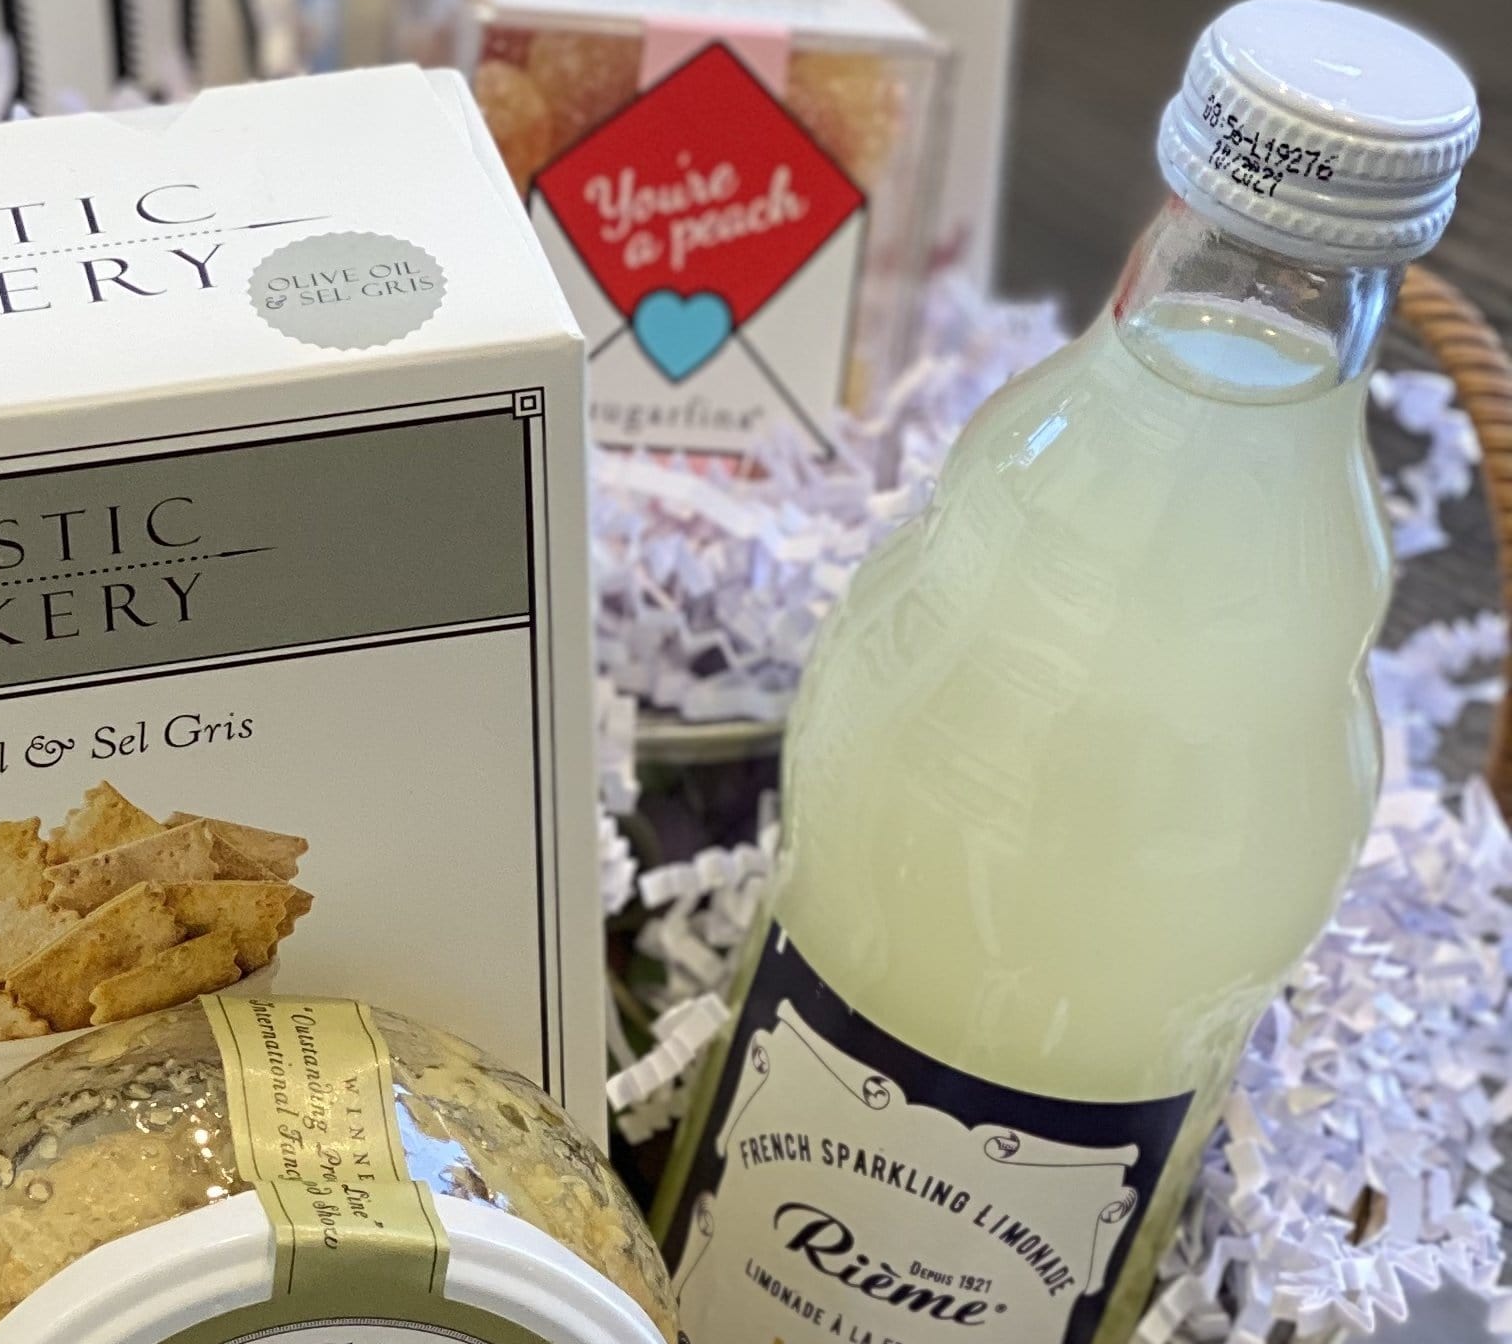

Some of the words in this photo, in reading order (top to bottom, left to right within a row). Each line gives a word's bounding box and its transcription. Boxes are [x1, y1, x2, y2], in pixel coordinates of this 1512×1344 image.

[585, 152, 740, 243] You're
[624, 230, 661, 269] a
[669, 165, 809, 271] peach
[265, 295, 287, 309] &
[300, 289, 351, 306] SEL
[361, 276, 434, 297] GRIS
[268, 267, 359, 291] OLIVE
[369, 261, 420, 278] OIL
[25, 733, 76, 770] &
[91, 722, 150, 761] Sel
[164, 710, 254, 750] Gris
[249, 999, 299, 1115] International
[312, 1200, 342, 1250] Show
[344, 1076, 375, 1182] WINNE
[740, 1132, 812, 1170] FRENCH
[821, 1138, 971, 1214] SPARKLING
[973, 1204, 1077, 1297] LIMONADE
[744, 1257, 825, 1327] LIMONADE
[958, 1274, 993, 1294] 1921
